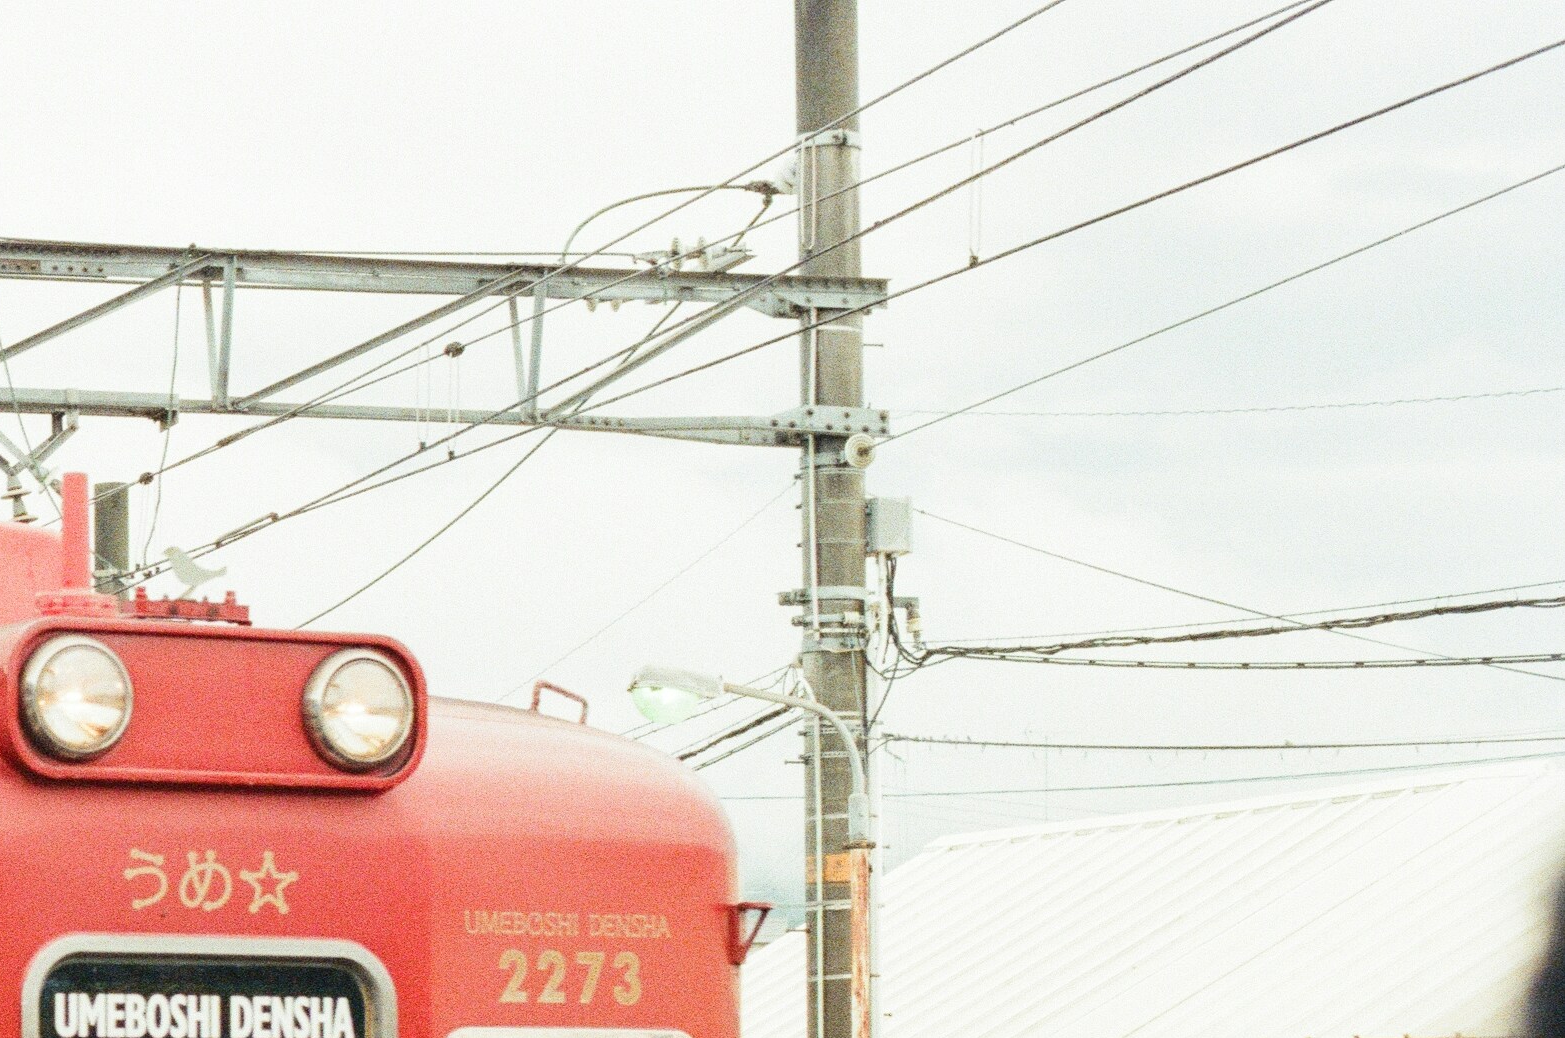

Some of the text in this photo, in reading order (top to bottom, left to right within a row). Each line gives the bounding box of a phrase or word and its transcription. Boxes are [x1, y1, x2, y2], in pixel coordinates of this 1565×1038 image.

[464, 910, 672, 938] UMEBOSHI DENSHA
[498, 948, 643, 1006] 2273
[54, 992, 221, 1038] UMEBOSHI
